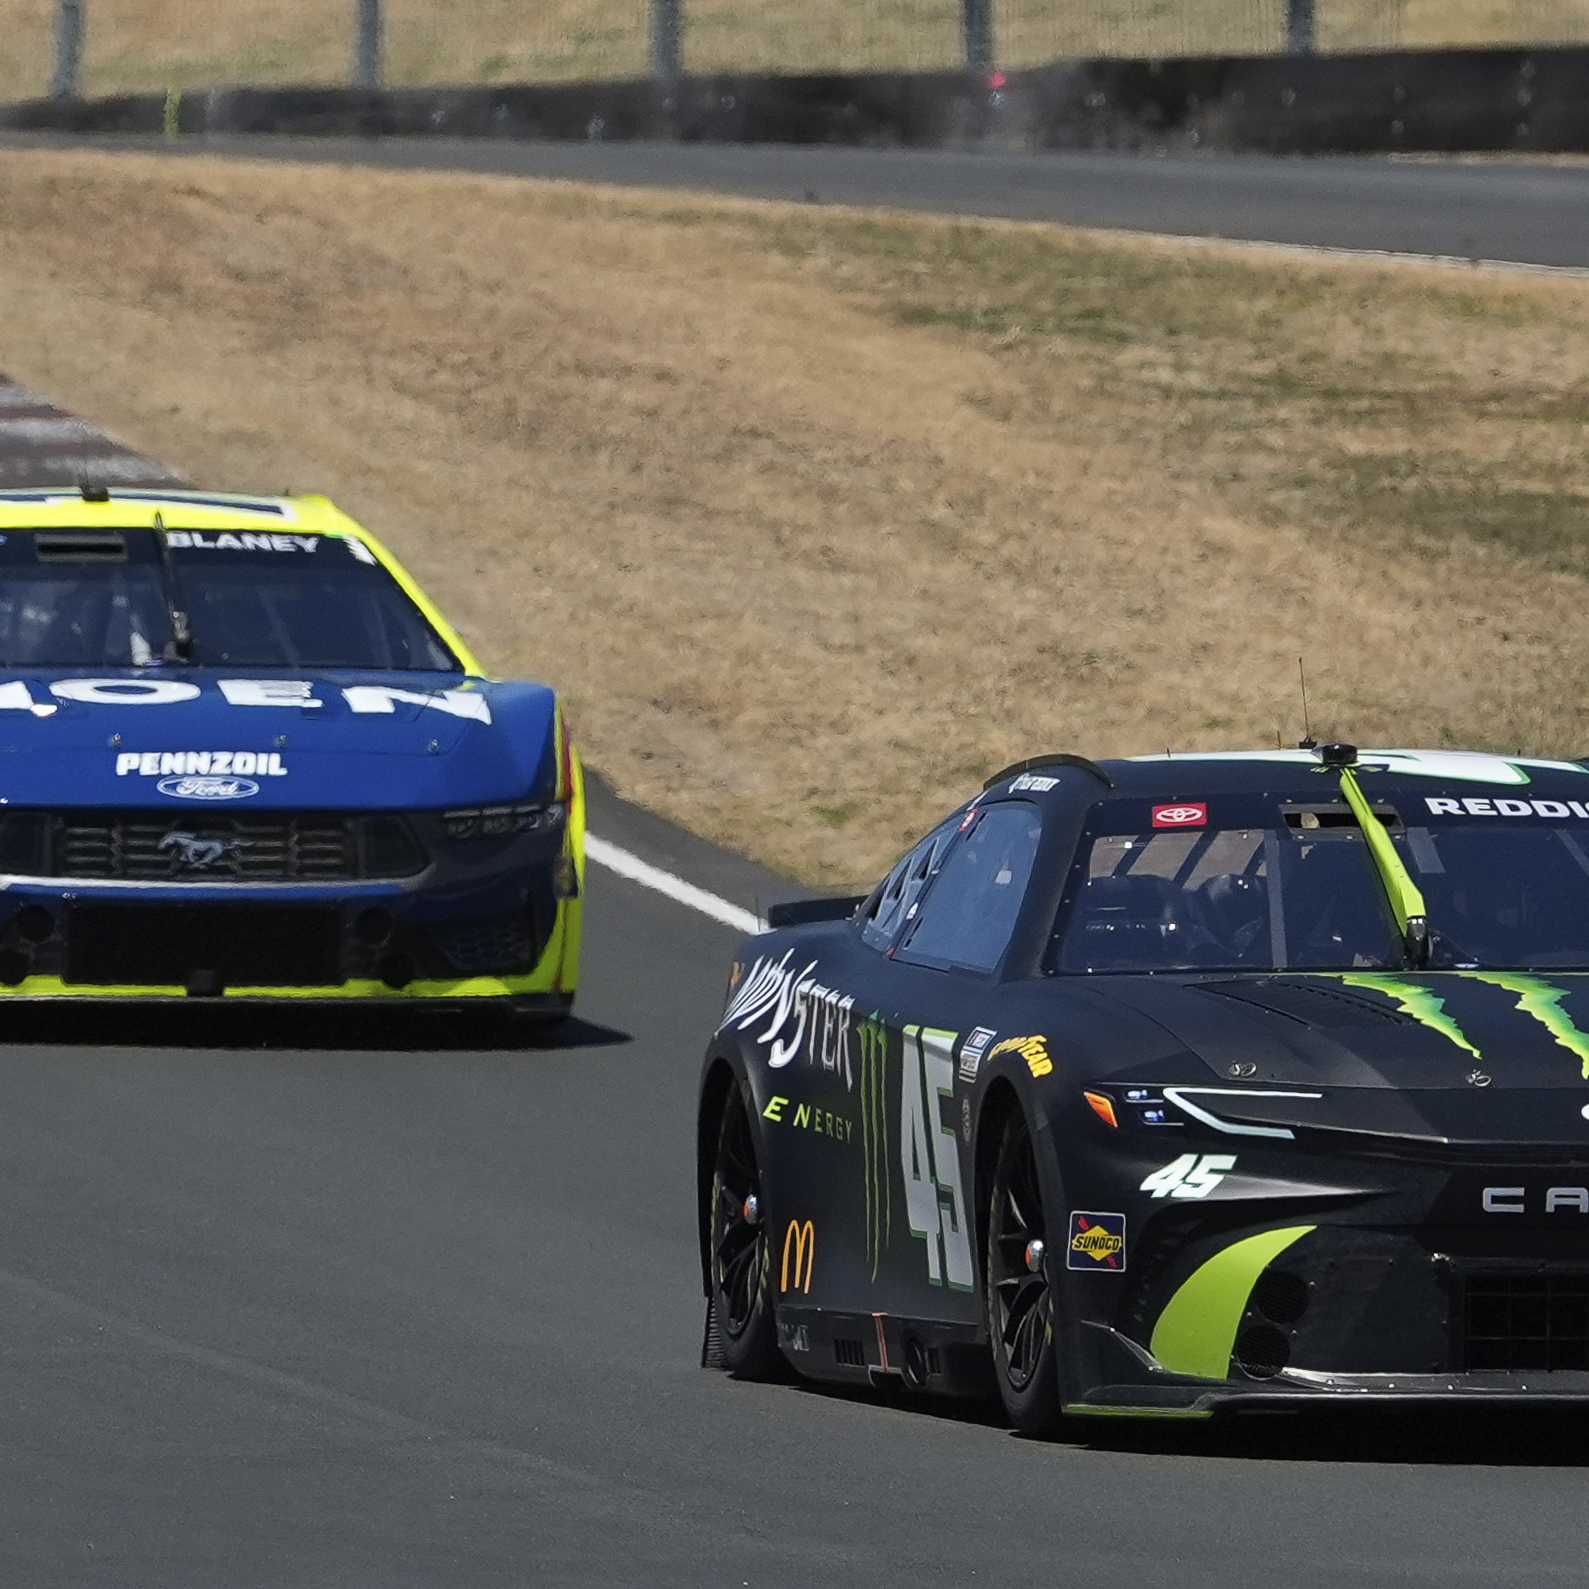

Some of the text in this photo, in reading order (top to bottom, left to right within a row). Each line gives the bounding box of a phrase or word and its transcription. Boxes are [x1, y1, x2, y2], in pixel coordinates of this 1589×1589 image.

[166, 531, 319, 553] BLANEY
[116, 751, 288, 776] PENNZOIL
[762, 1095, 853, 1144] ENERGY
[900, 1024, 975, 1294] 45
[1139, 1153, 1239, 1199] 45
[1074, 1234, 1122, 1251] SUNOCO
